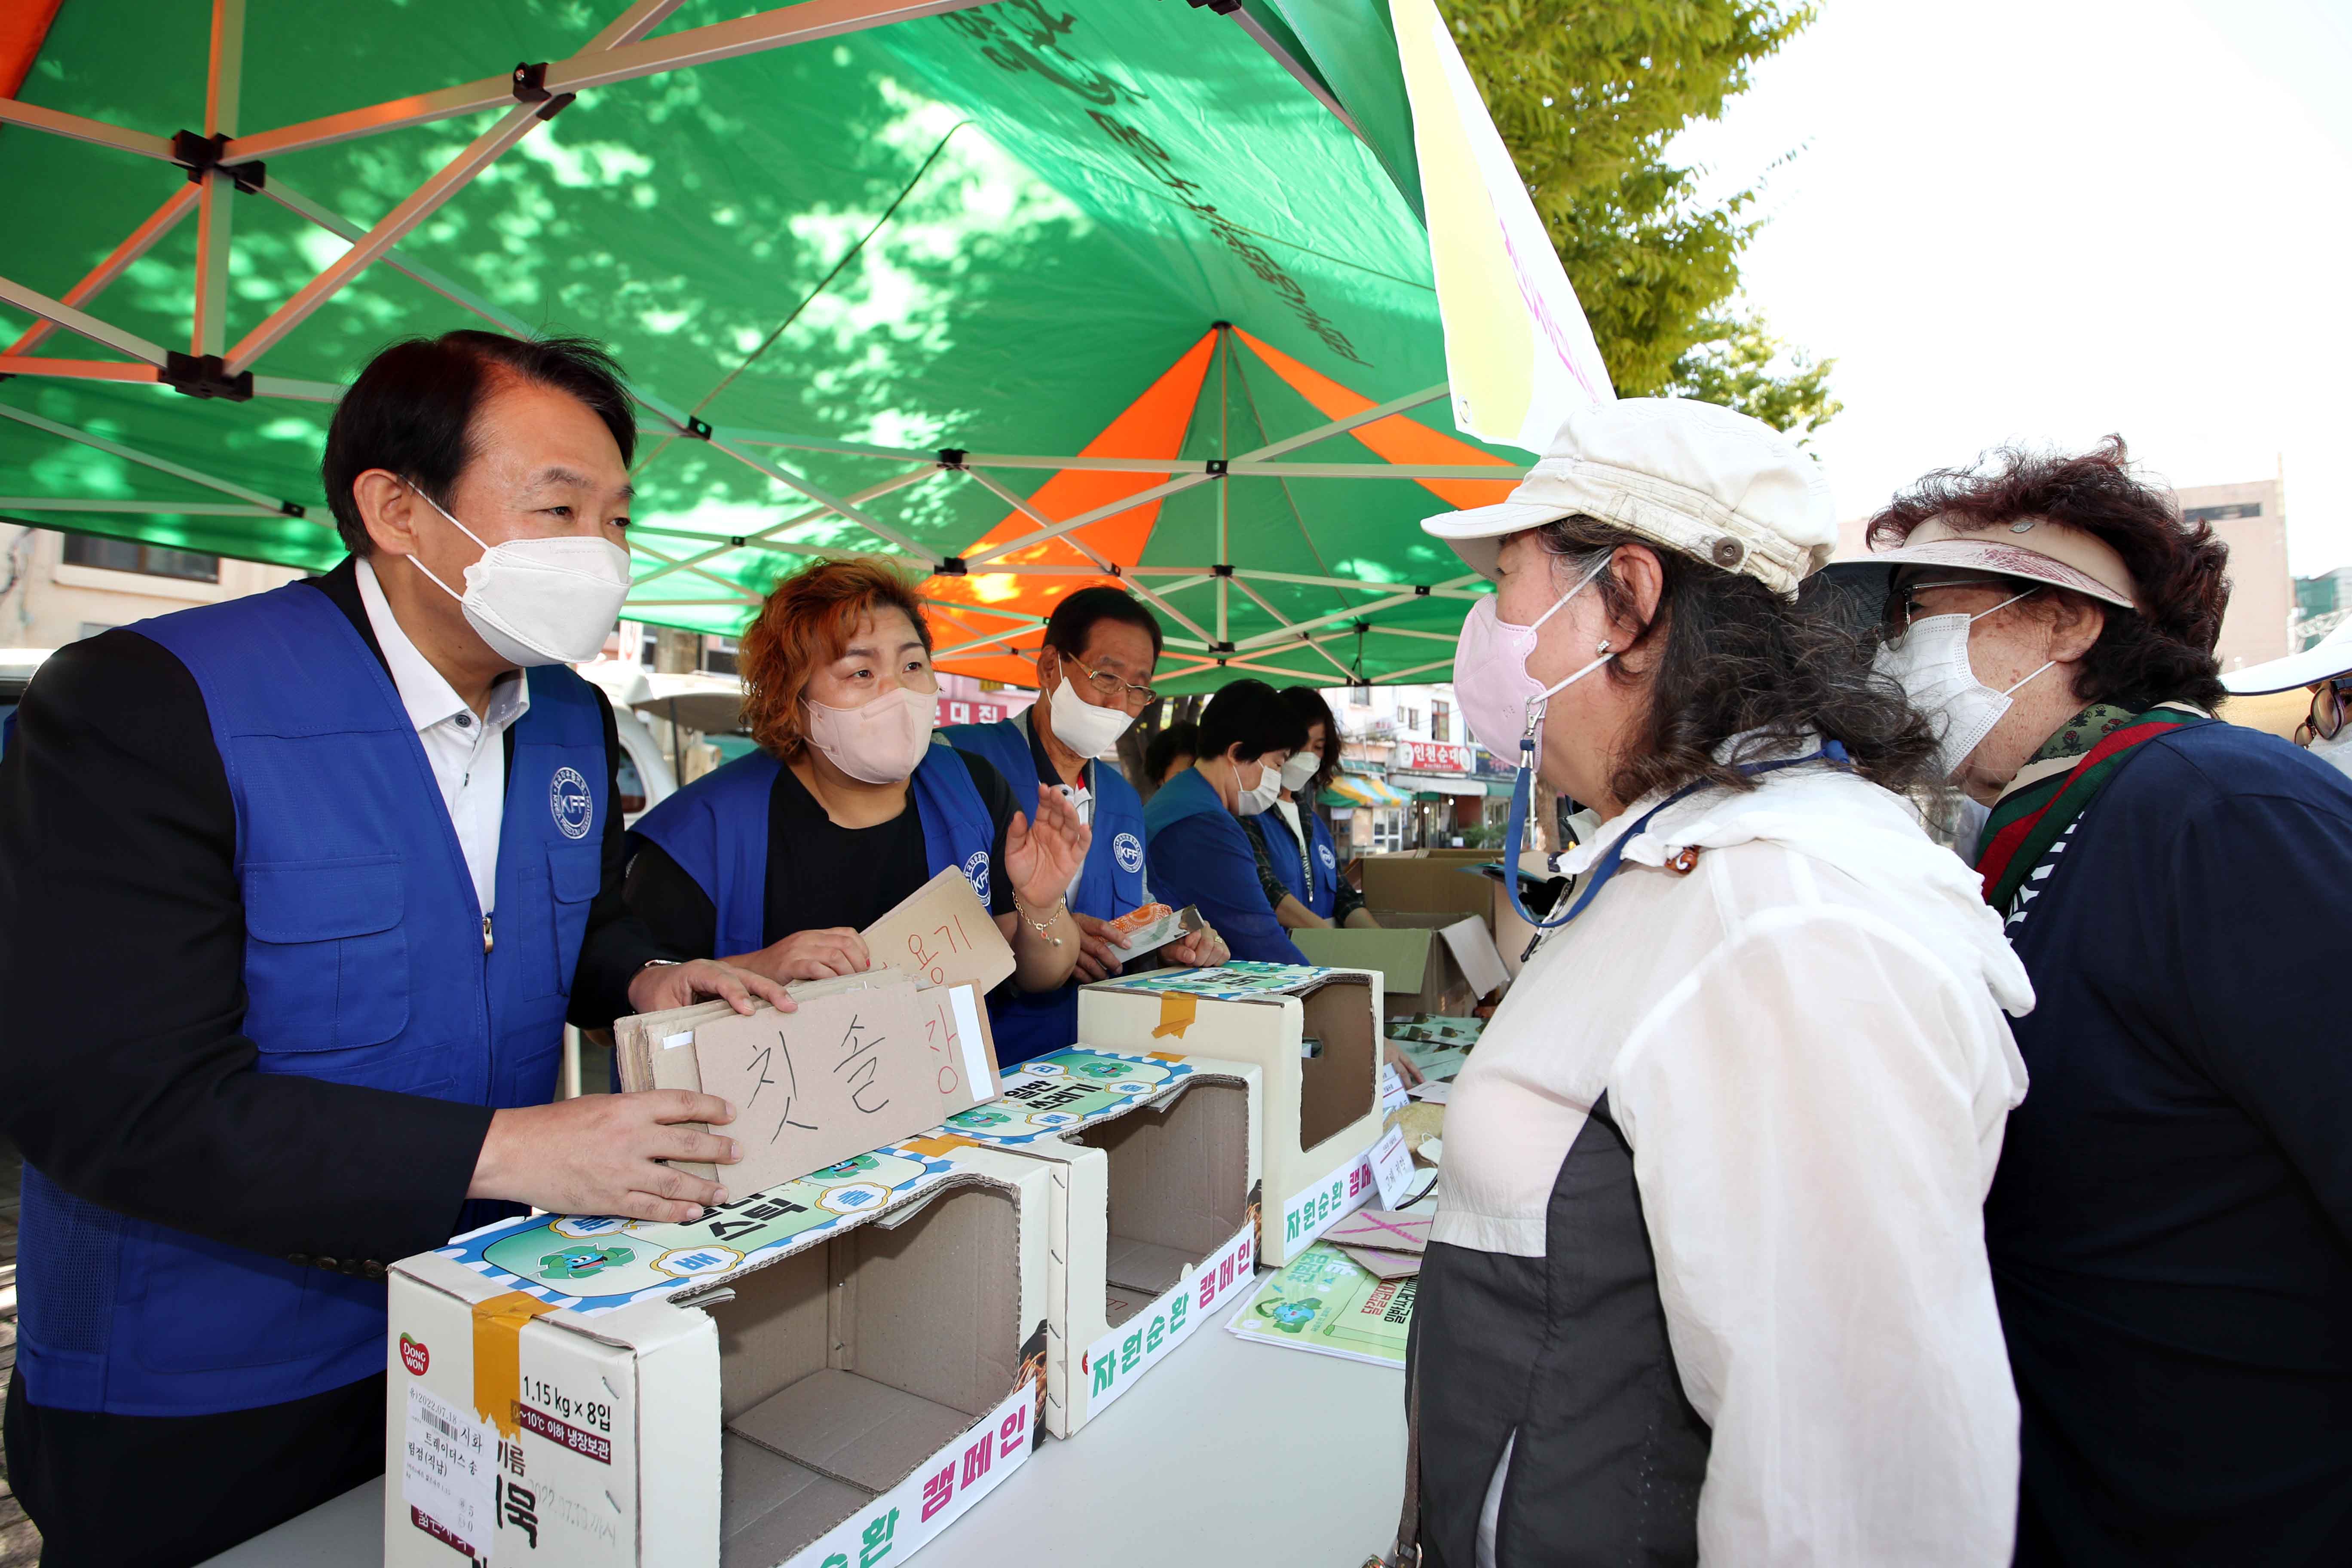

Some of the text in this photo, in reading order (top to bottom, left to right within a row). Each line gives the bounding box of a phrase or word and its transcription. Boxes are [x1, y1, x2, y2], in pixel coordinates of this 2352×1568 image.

[559, 795, 585, 814] KFF
[1121, 846, 1138, 860] KFF
[1004, 1080, 1061, 1100] 일반
[1025, 1083, 1104, 1110] 쓰레기
[1039, 1114, 1071, 1124] 배
[709, 1197, 809, 1241] 스틱
[1286, 1179, 1343, 1243] 자원순환
[683, 1253, 717, 1272] 배
[1092, 1237, 1251, 1399] 자원순환 캠페인
[404, 1342, 426, 1362] DONG
[406, 1356, 424, 1372] WON
[524, 1375, 551, 1406] 1.15
[555, 1387, 570, 1418] kg
[587, 1402, 610, 1432] 8입
[424, 1431, 466, 1468] 트레이더스
[469, 1461, 478, 1475] 송
[460, 1427, 482, 1454] 시화
[547, 1420, 565, 1441] 이하
[567, 1428, 609, 1460] 냉장보관
[921, 1403, 1027, 1523] 캠페인
